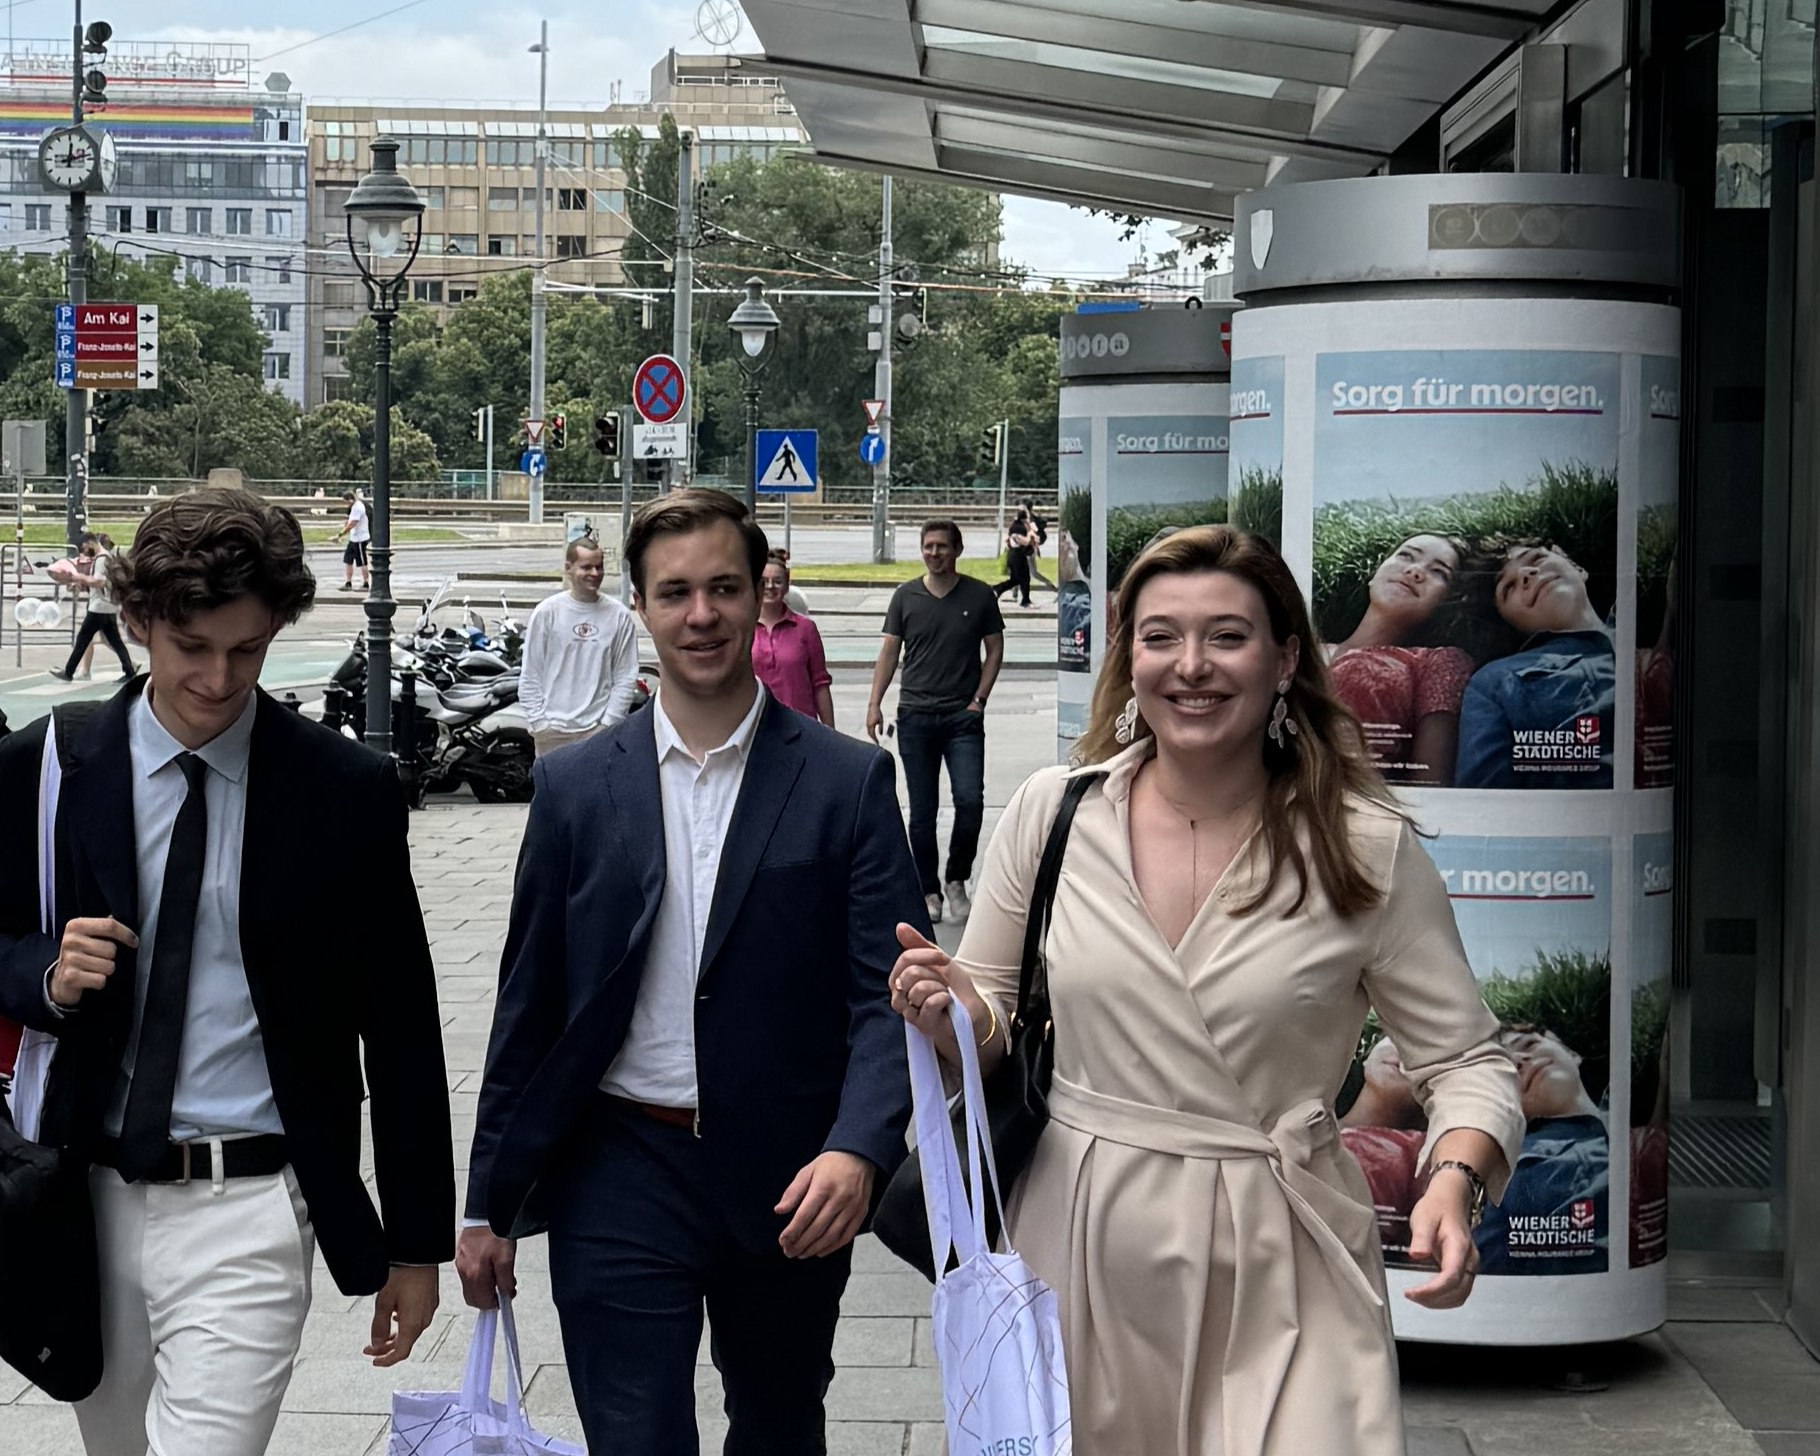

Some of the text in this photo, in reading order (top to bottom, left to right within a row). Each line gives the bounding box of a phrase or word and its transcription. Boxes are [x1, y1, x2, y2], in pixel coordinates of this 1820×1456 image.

[166, 51, 246, 76] GROUP
[84, 312, 130, 324] Am Kai
[1333, 377, 1603, 411] Sorg für morgen.
[1117, 432, 1229, 452] Sorg für mo
[1513, 730, 1575, 744] WIENER
[1462, 870, 1595, 897] morgen.
[1509, 1216, 1570, 1230] WIENER
